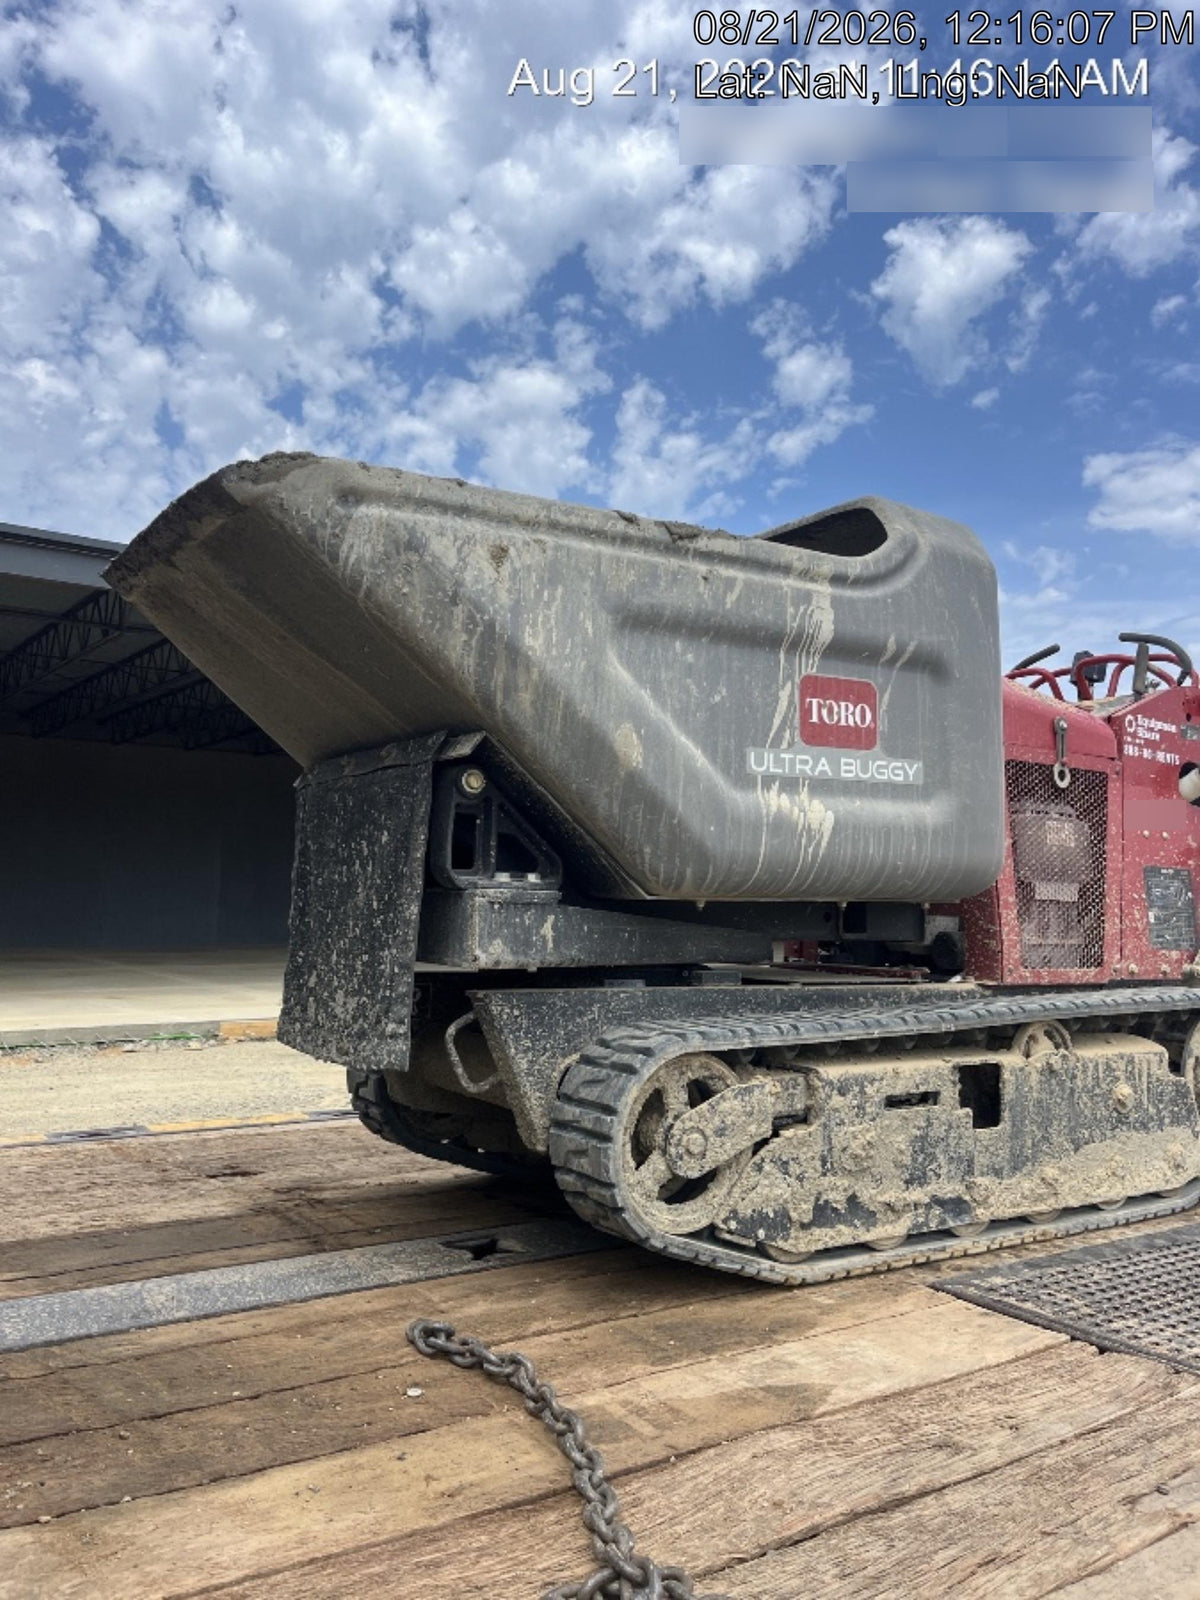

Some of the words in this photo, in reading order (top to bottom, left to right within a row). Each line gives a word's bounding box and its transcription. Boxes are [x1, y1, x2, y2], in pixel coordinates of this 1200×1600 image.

[805, 697, 872, 728] TORO
[750, 752, 832, 776] ULTRA
[840, 757, 919, 781] BUGGY
